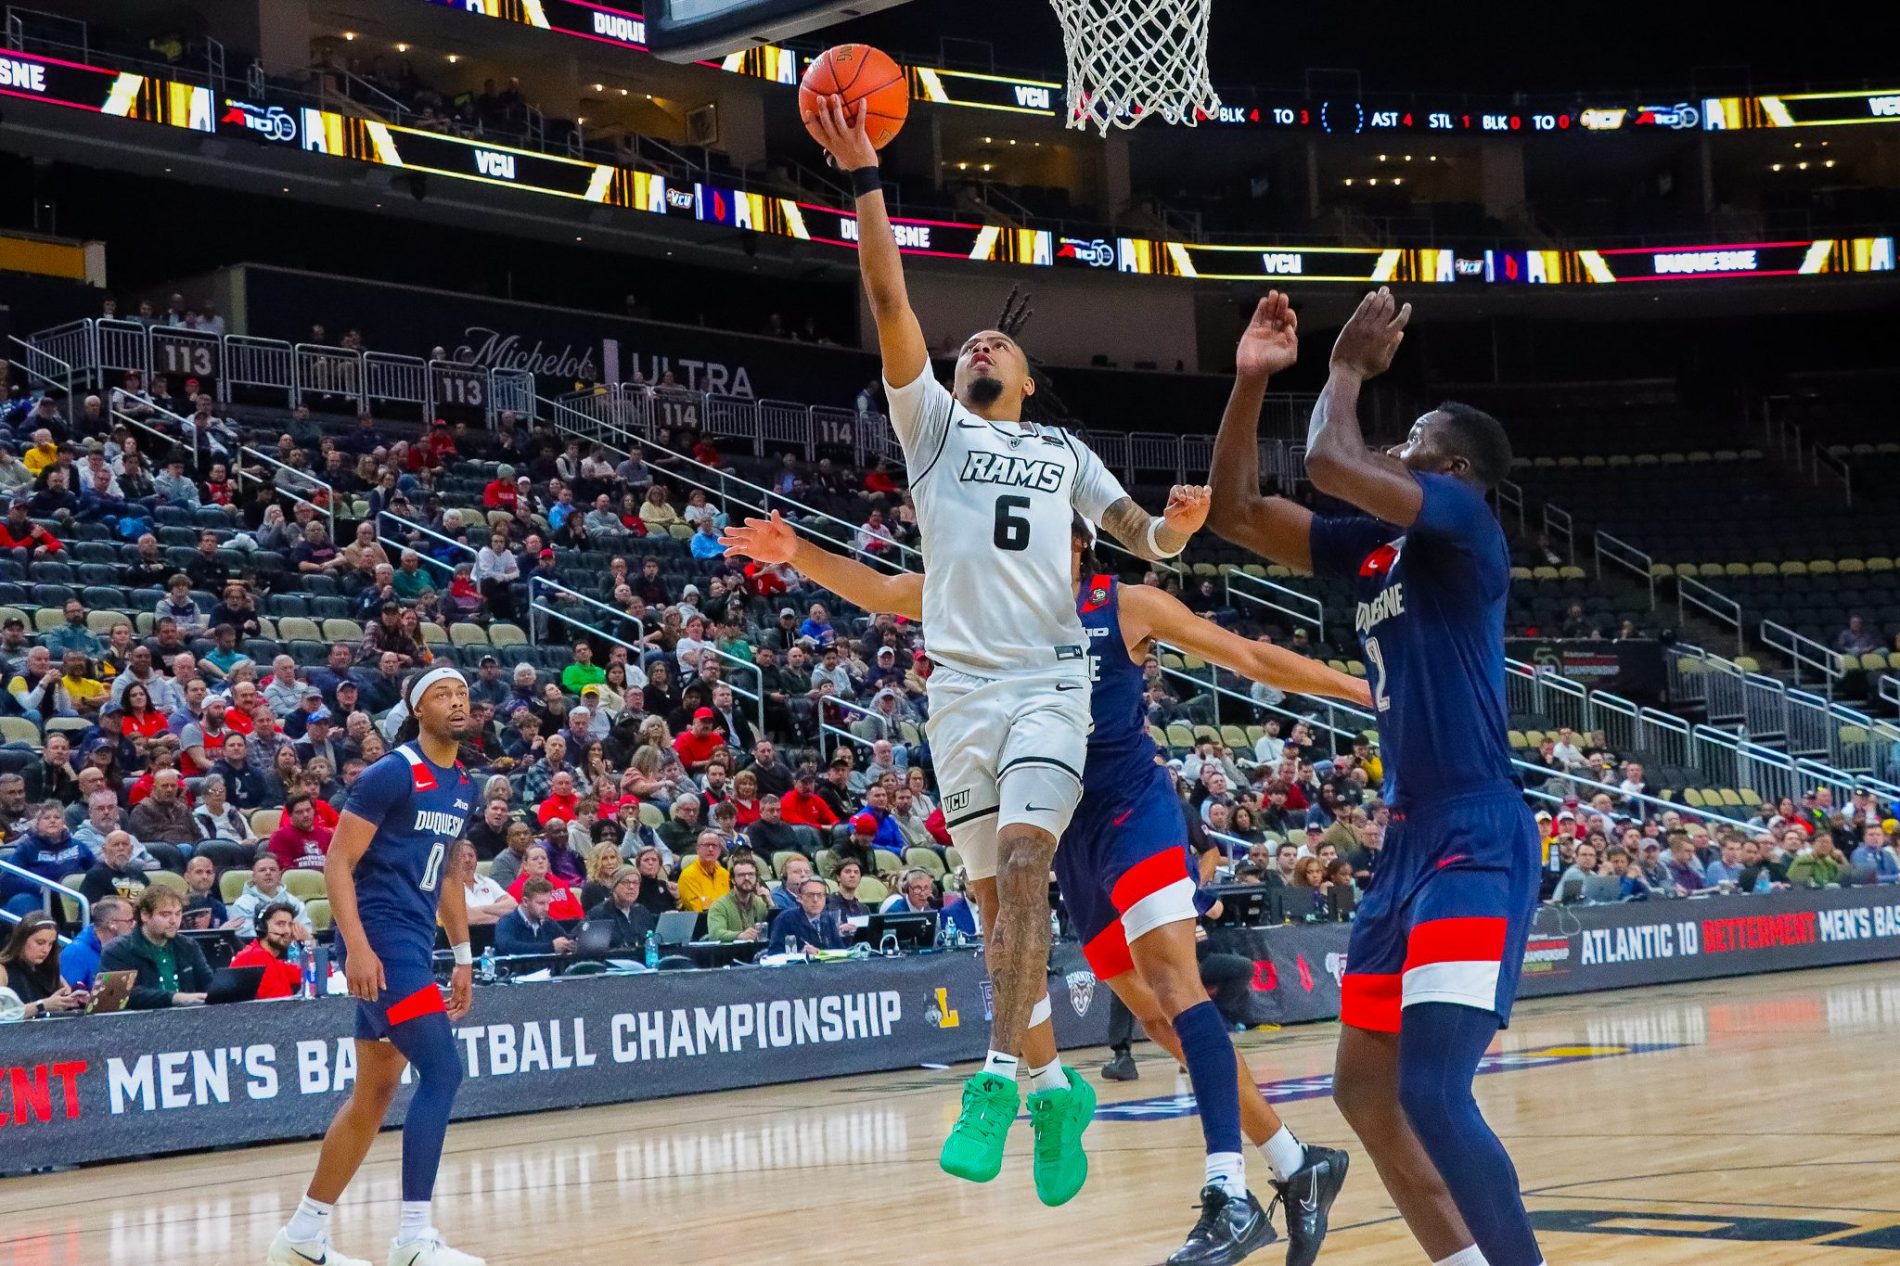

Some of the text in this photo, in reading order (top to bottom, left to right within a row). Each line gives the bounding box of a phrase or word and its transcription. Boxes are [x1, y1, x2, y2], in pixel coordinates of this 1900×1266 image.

[593, 11, 646, 44] DUQUE
[1015, 86, 1049, 109] VCU
[1868, 96, 1900, 116] VC
[1219, 106, 1246, 123] BLK
[1250, 108, 1260, 122] 4
[1273, 109, 1294, 124] TO
[1300, 110, 1309, 124] 3
[1371, 112, 1570, 130] AST 4 STL 1 BLK 0 TO 0
[474, 150, 515, 179] VCU
[671, 191, 691, 207] VCU
[840, 218, 931, 248] DUSNE
[1263, 253, 1302, 274] VCU
[164, 344, 213, 376] 113
[453, 327, 756, 400] Michelob ULTRA
[442, 377, 482, 406] 113
[662, 402, 698, 429] 114
[820, 420, 851, 445] 114
[960, 451, 1064, 493] RAMS
[993, 494, 1031, 551] 6
[1365, 637, 1391, 712] 2
[944, 789, 970, 814] VCU
[413, 810, 465, 838] DUQUESN
[419, 842, 445, 892] 0
[1581, 923, 1673, 965] ATLANTIC
[1676, 921, 1699, 956] 10
[1702, 911, 1816, 954] BETTERMENT
[1818, 907, 1871, 942] MEN'S
[107, 1043, 279, 1115] MEN'S
[297, 1016, 597, 1095] BATBALL
[611, 990, 901, 1063] CHAMPIONSHIP
